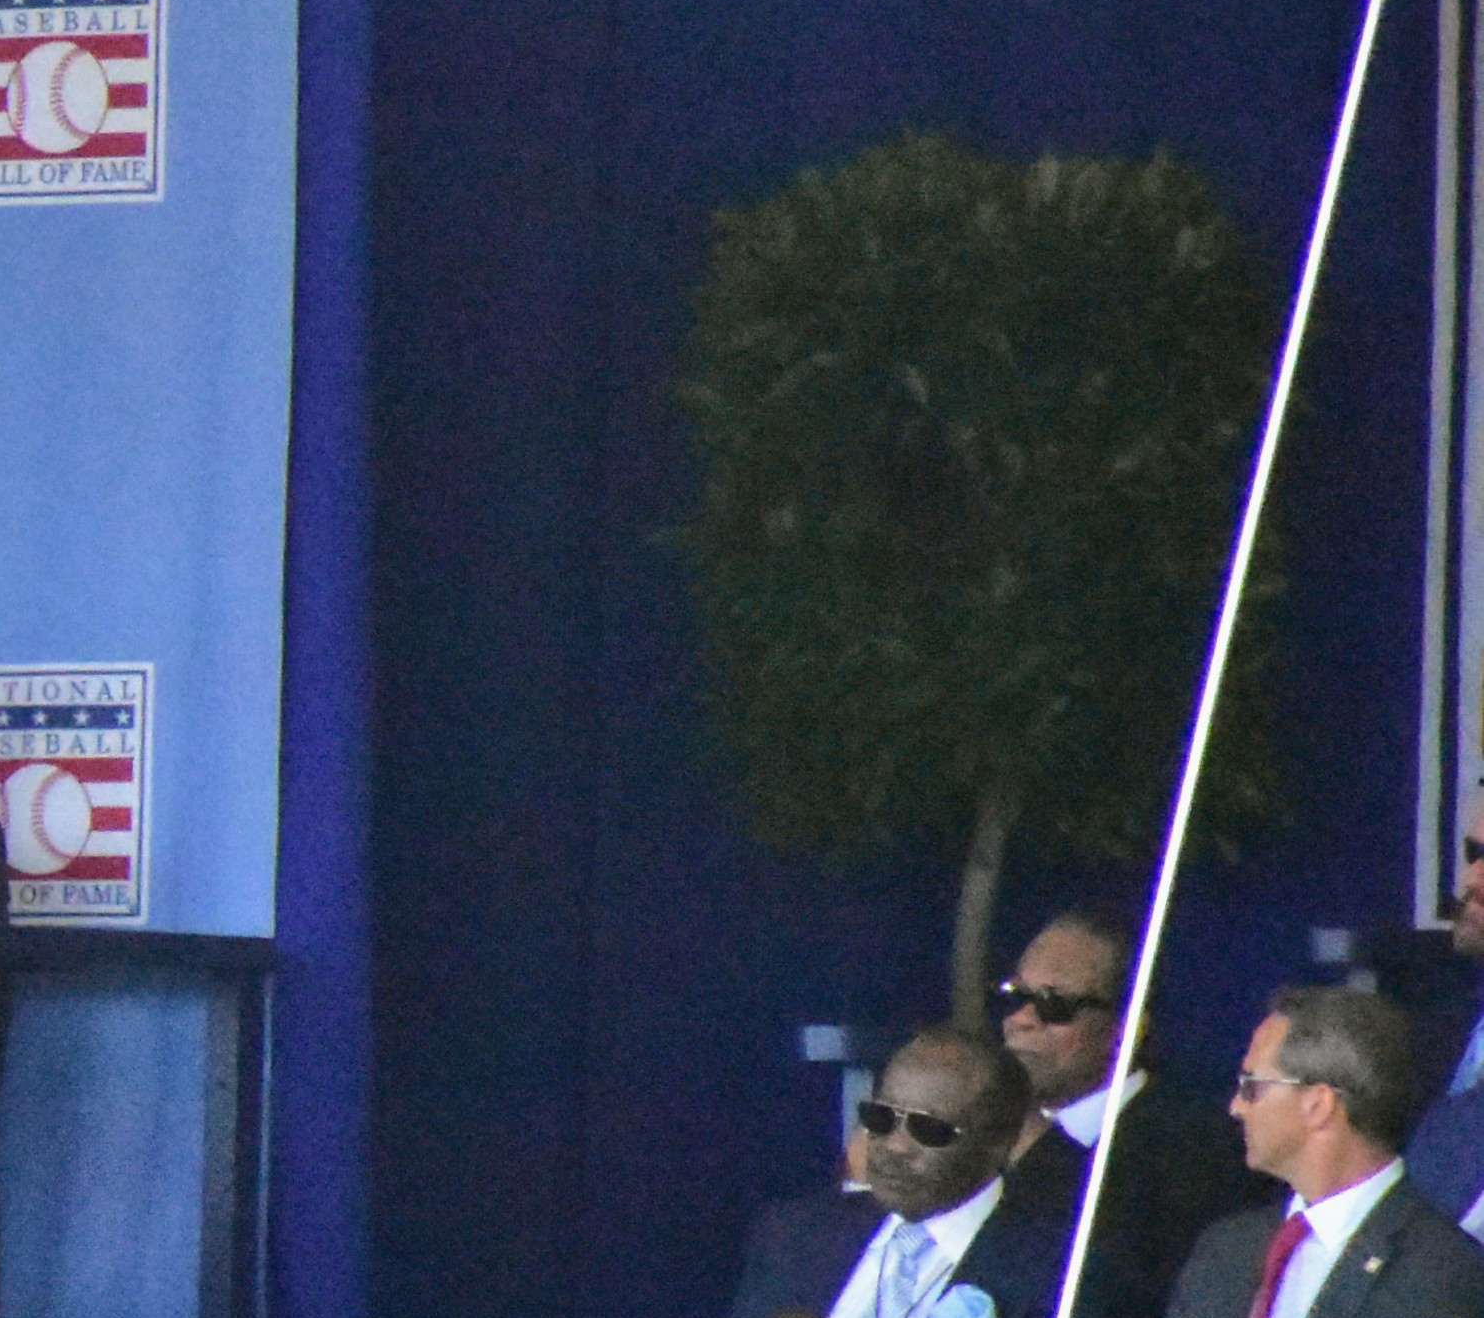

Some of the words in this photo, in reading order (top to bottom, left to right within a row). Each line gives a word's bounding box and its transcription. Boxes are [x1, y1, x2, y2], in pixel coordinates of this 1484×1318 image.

[36, 162, 70, 185] OF
[79, 160, 148, 183] FAME
[20, 884, 54, 905] OF
[63, 884, 130, 905] FAME
